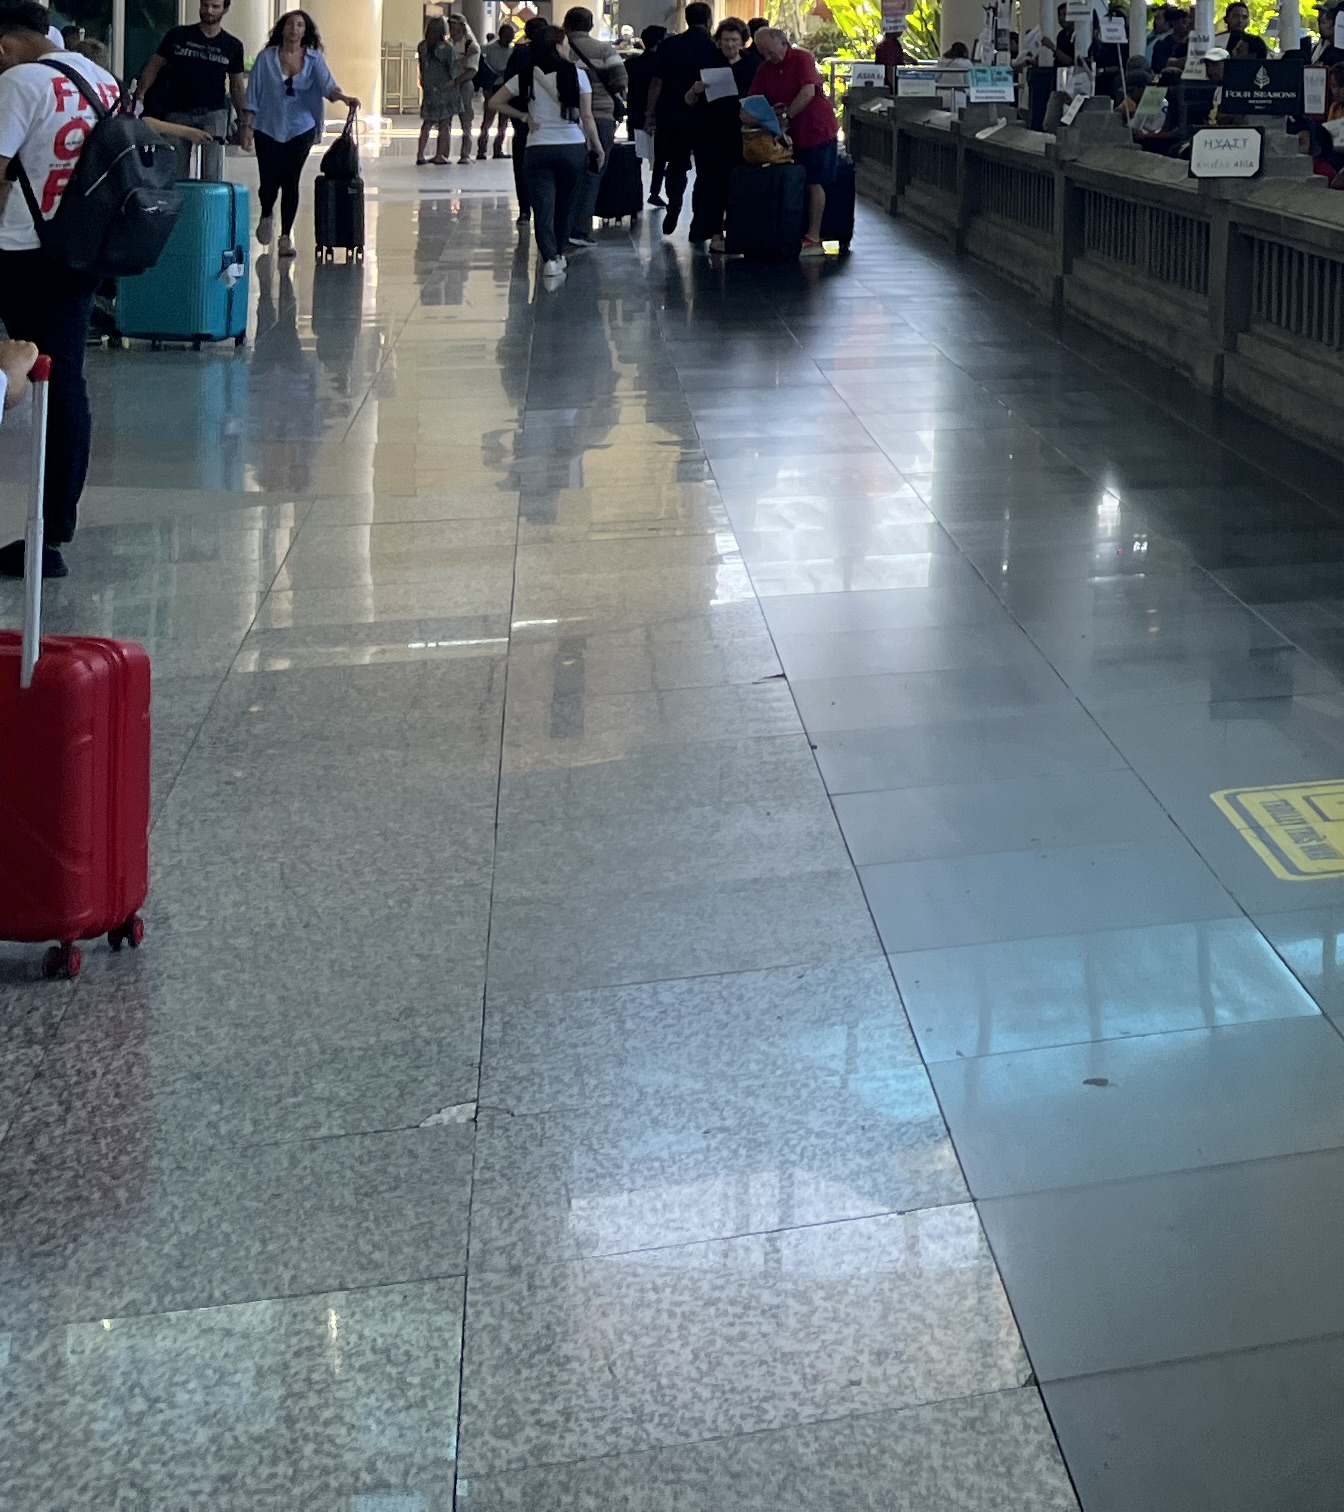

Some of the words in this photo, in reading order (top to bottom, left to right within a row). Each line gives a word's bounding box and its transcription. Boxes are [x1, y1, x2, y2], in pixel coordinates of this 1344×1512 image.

[1225, 89, 1251, 99] FOUR
[1253, 89, 1297, 99] SEASONS
[1204, 138, 1248, 150] HYATT
